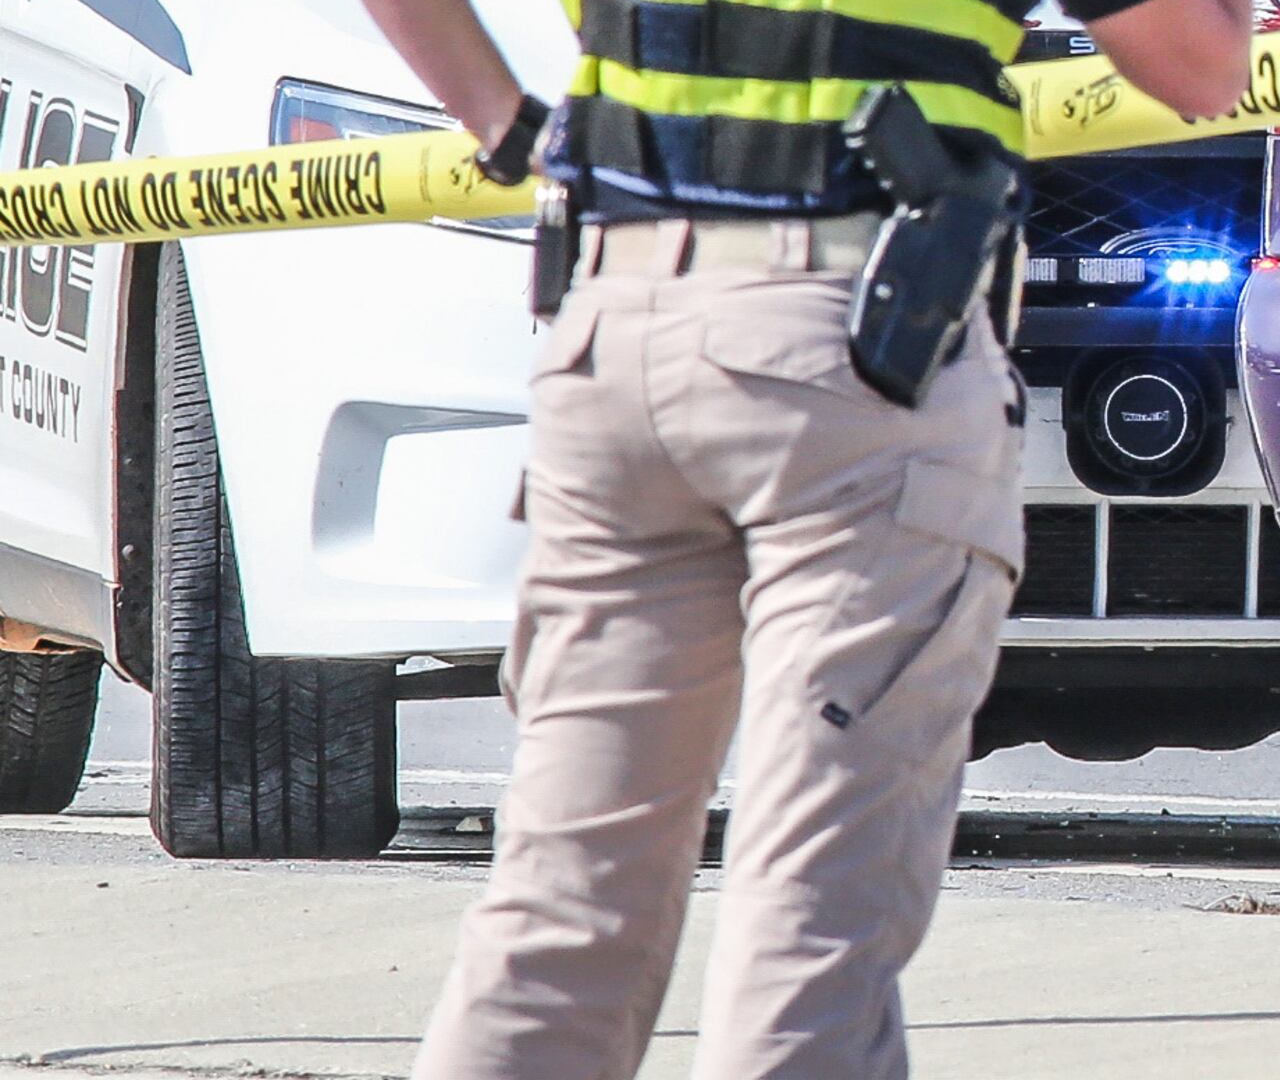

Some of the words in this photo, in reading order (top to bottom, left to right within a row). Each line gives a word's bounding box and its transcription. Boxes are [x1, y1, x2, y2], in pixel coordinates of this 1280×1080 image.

[0, 182, 82, 241] CROS
[81, 176, 146, 236] NOT
[141, 172, 193, 231] DO
[189, 161, 287, 227] SCENE
[290, 151, 386, 219] CRIME
[12, 359, 81, 443] COUNTY
